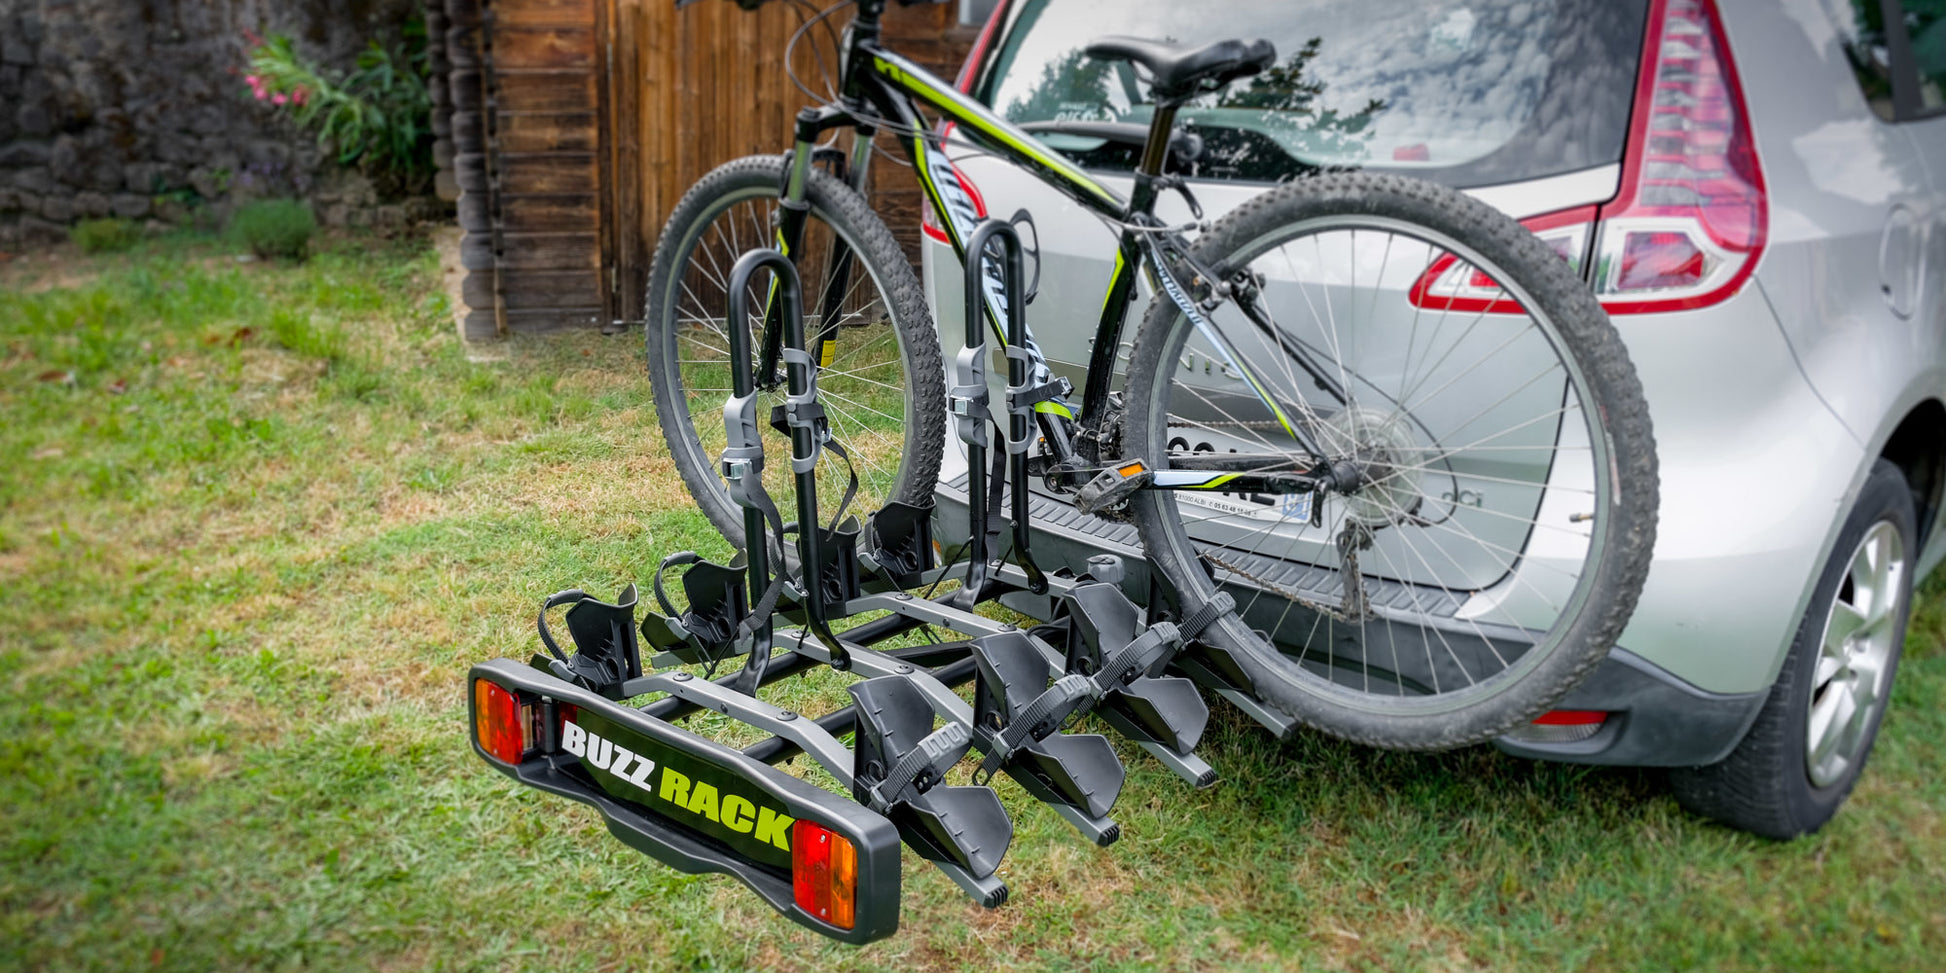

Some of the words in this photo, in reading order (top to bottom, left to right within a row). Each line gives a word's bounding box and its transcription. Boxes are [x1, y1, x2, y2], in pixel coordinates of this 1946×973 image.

[1194, 497, 1207, 505] ALBI
[562, 720, 655, 792] BUZZ
[659, 766, 795, 852] RACK
